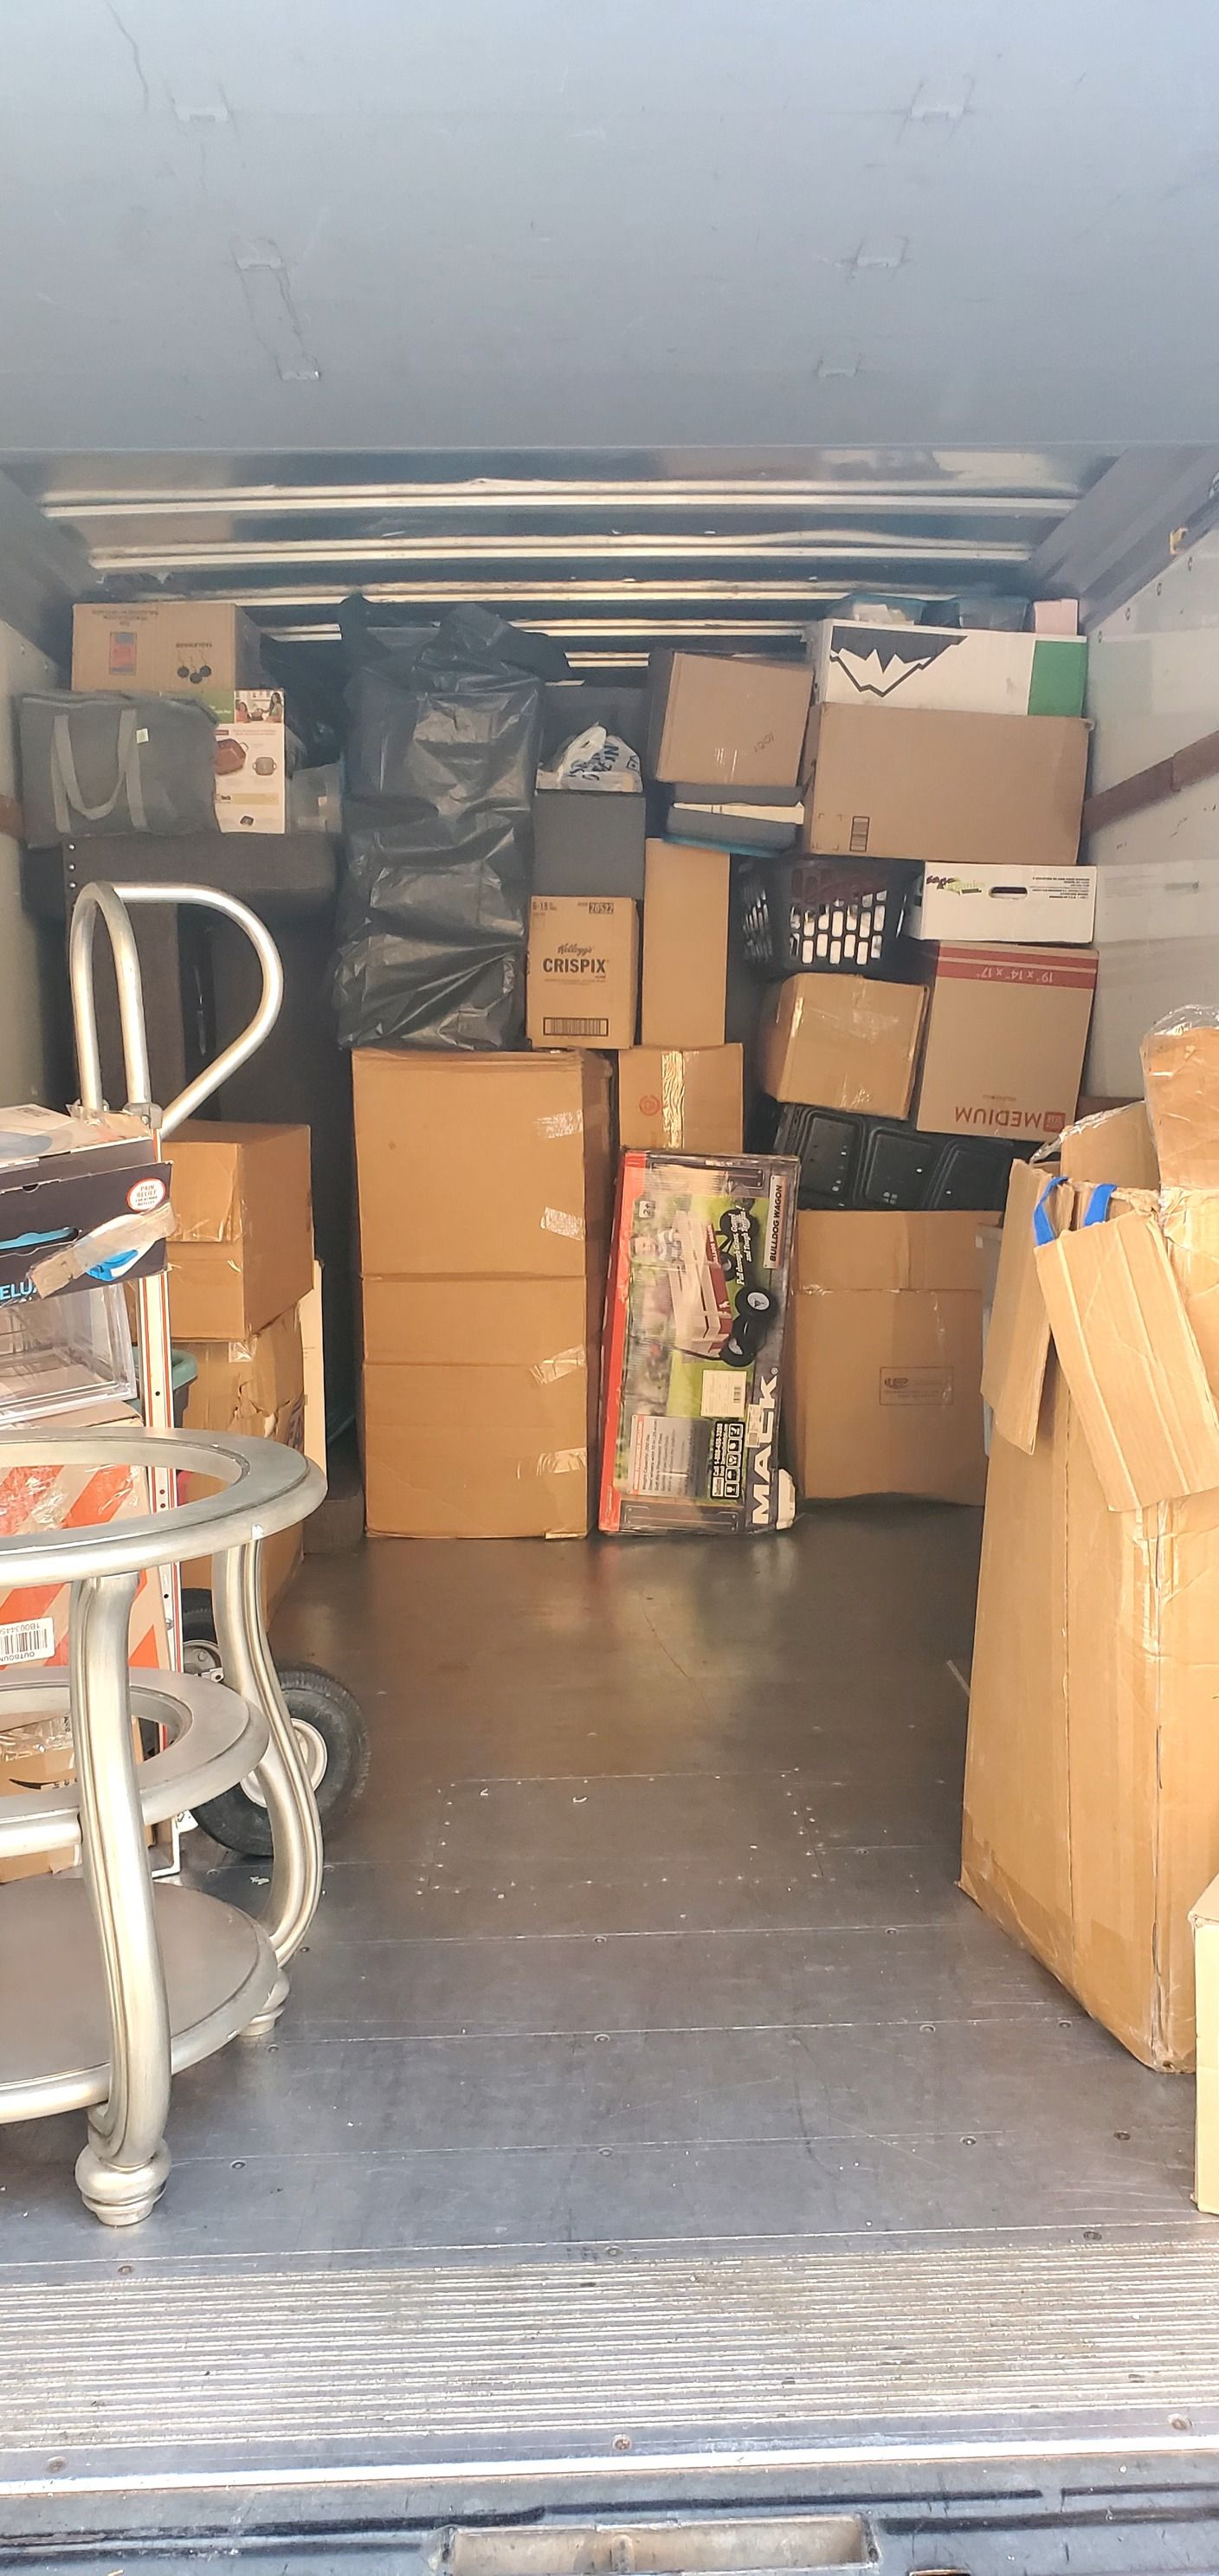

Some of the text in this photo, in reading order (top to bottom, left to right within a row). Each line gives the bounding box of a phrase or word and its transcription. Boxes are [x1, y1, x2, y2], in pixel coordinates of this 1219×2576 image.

[557, 943, 593, 957] Kellogg's
[543, 958, 606, 973] CRISPIX
[955, 1107, 1042, 1129] MEDIUM
[770, 1184, 783, 1262] BULLDOG WAGON
[0, 1281, 36, 1300] ELU
[751, 1375, 778, 1525] MACK
